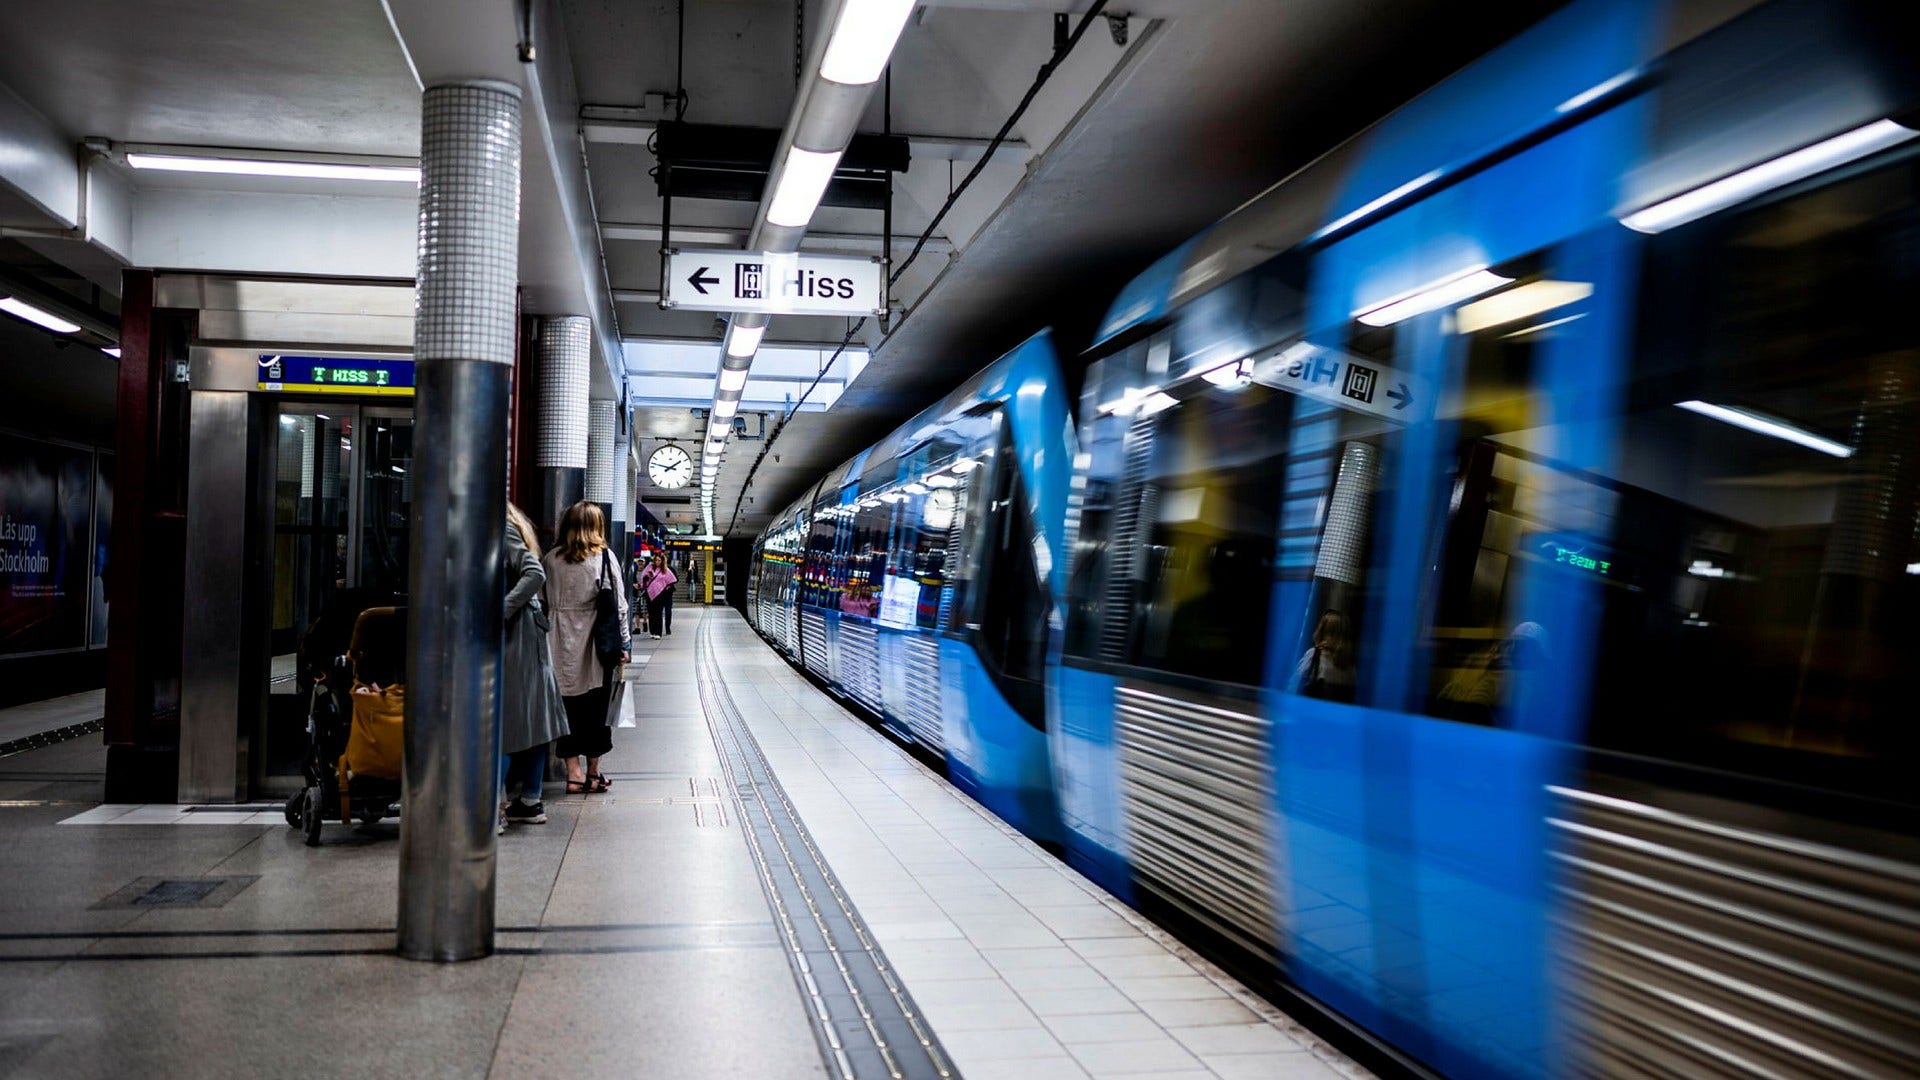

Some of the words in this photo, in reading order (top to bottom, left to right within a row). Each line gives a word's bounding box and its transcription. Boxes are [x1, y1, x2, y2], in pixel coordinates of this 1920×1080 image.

[782, 269, 855, 299] Hiss
[333, 369, 368, 382] HISS
[0, 514, 16, 540] Lås
[18, 523, 37, 548] upp
[0, 548, 49, 573] Stockholm
